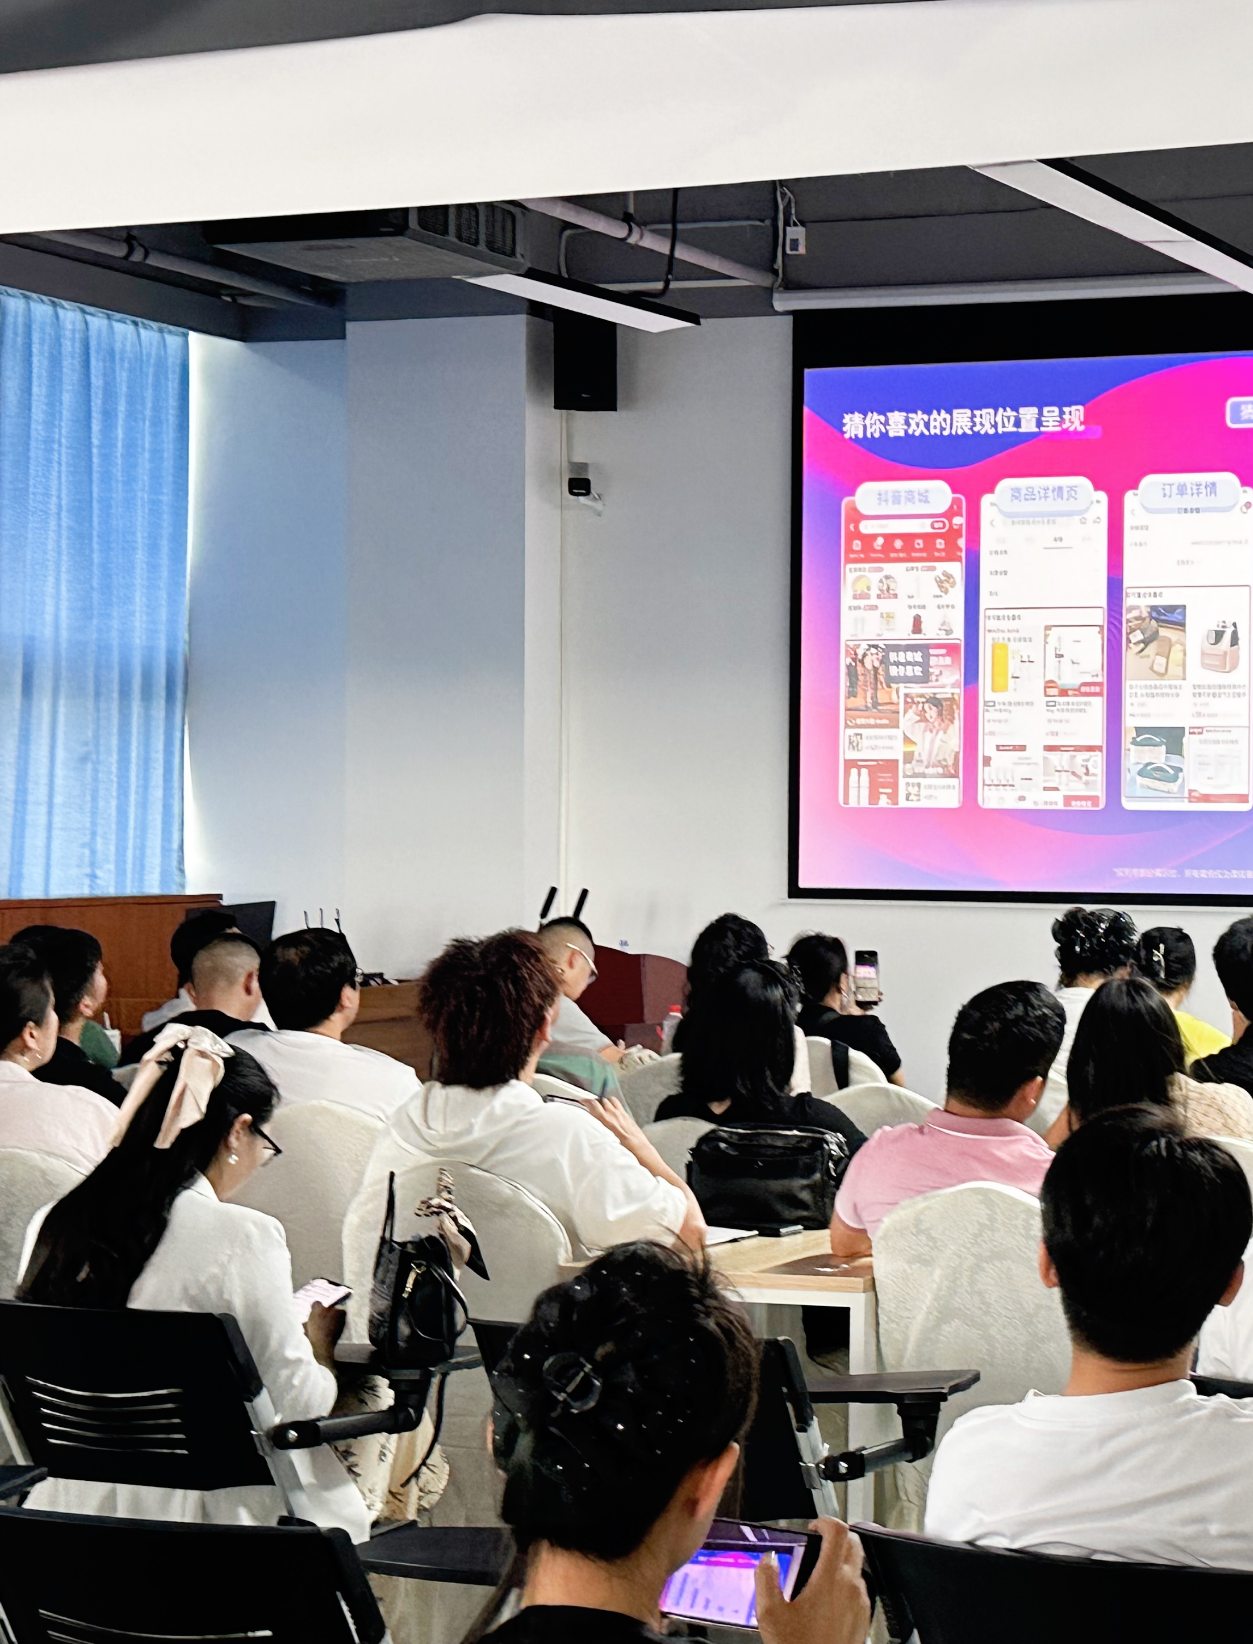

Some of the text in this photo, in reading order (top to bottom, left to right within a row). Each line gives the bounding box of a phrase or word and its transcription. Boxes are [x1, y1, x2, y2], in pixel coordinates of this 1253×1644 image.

[842, 405, 1086, 440] 猜你喜欢的展现位置呈现
[876, 488, 931, 506] 抖音商城
[1009, 485, 1079, 503] 商品详情页
[1161, 481, 1218, 499] 订单详情
